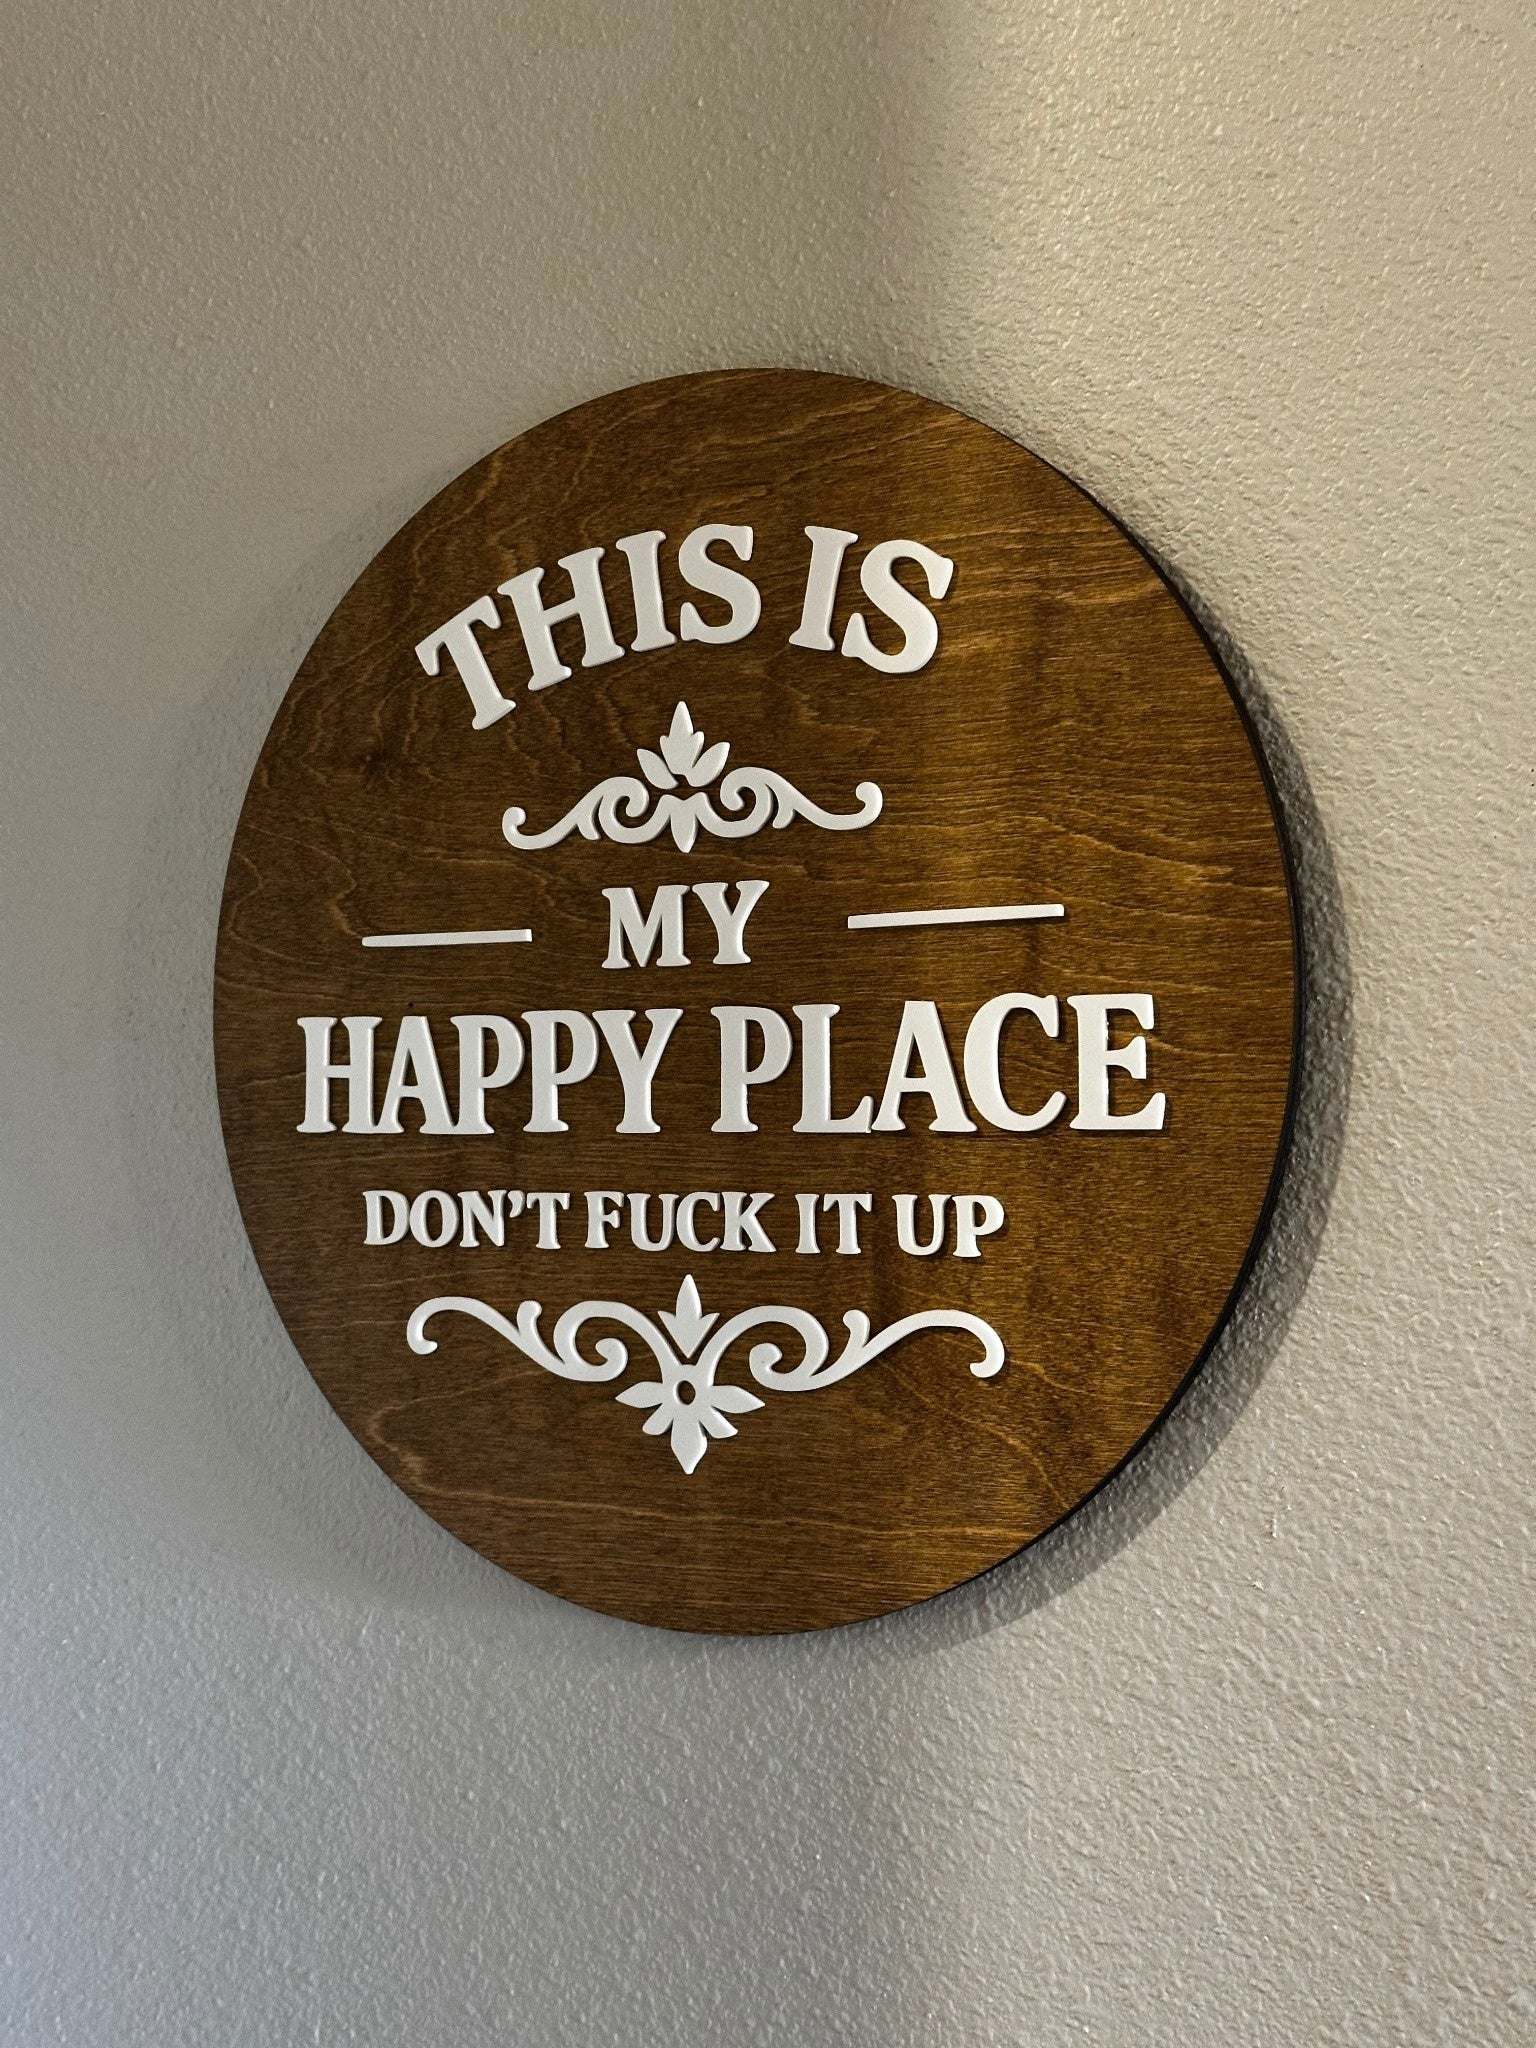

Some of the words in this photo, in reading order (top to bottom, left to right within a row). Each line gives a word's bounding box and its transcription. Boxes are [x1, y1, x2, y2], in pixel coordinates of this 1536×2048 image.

[415, 523, 762, 731] THIS
[788, 525, 955, 674] IS
[600, 880, 769, 969] MY
[296, 1008, 684, 1135] HAPPY
[710, 992, 1166, 1133] PLACE
[362, 1189, 571, 1250] DON'T
[583, 1190, 776, 1253] FUCK
[794, 1193, 873, 1255] IT
[891, 1193, 1004, 1258] UP
